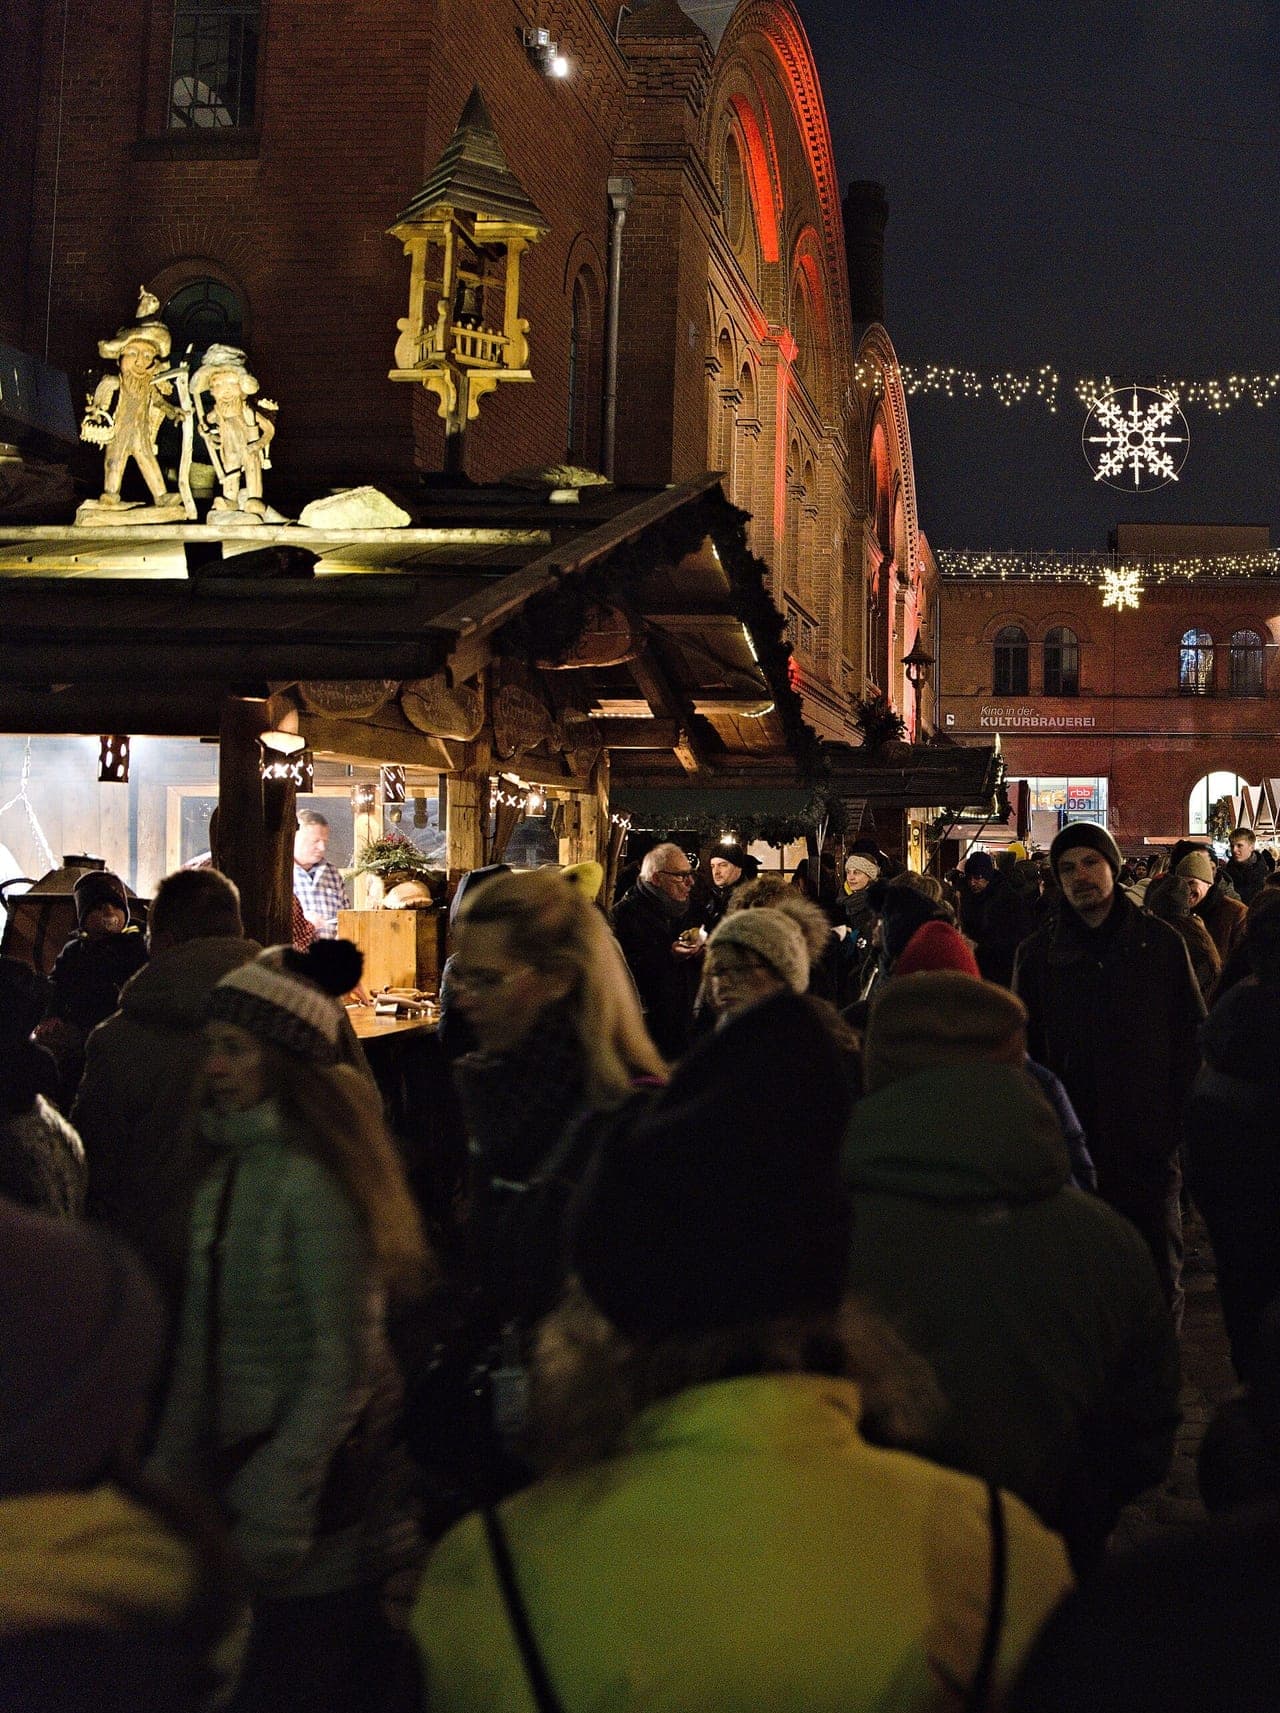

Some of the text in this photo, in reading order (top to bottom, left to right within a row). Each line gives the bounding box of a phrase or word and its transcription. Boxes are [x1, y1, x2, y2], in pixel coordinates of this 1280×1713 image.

[980, 705, 1035, 716] Kino in der
[980, 717, 1096, 727] KULTURBRAUEREI
[1070, 788, 1091, 797] rbb
